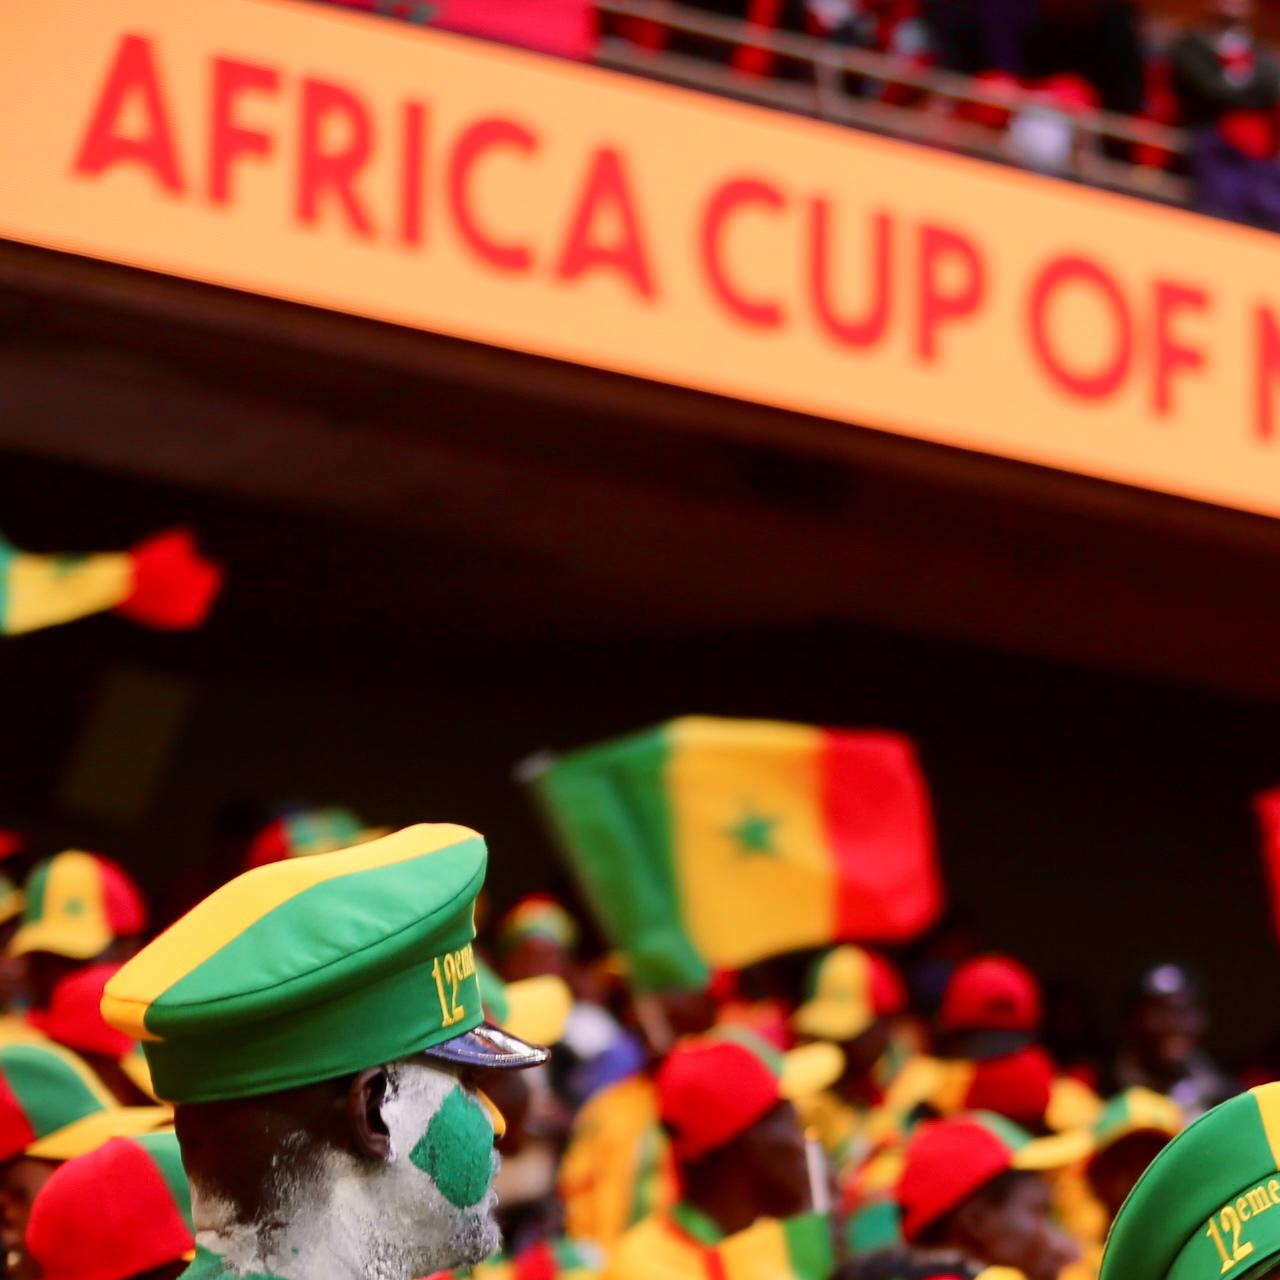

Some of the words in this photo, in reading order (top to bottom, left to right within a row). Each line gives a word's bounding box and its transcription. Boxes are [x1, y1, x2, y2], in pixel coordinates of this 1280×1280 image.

[70, 32, 661, 304] AFRICA
[697, 174, 989, 364] CUP
[1025, 252, 1211, 418] OF
